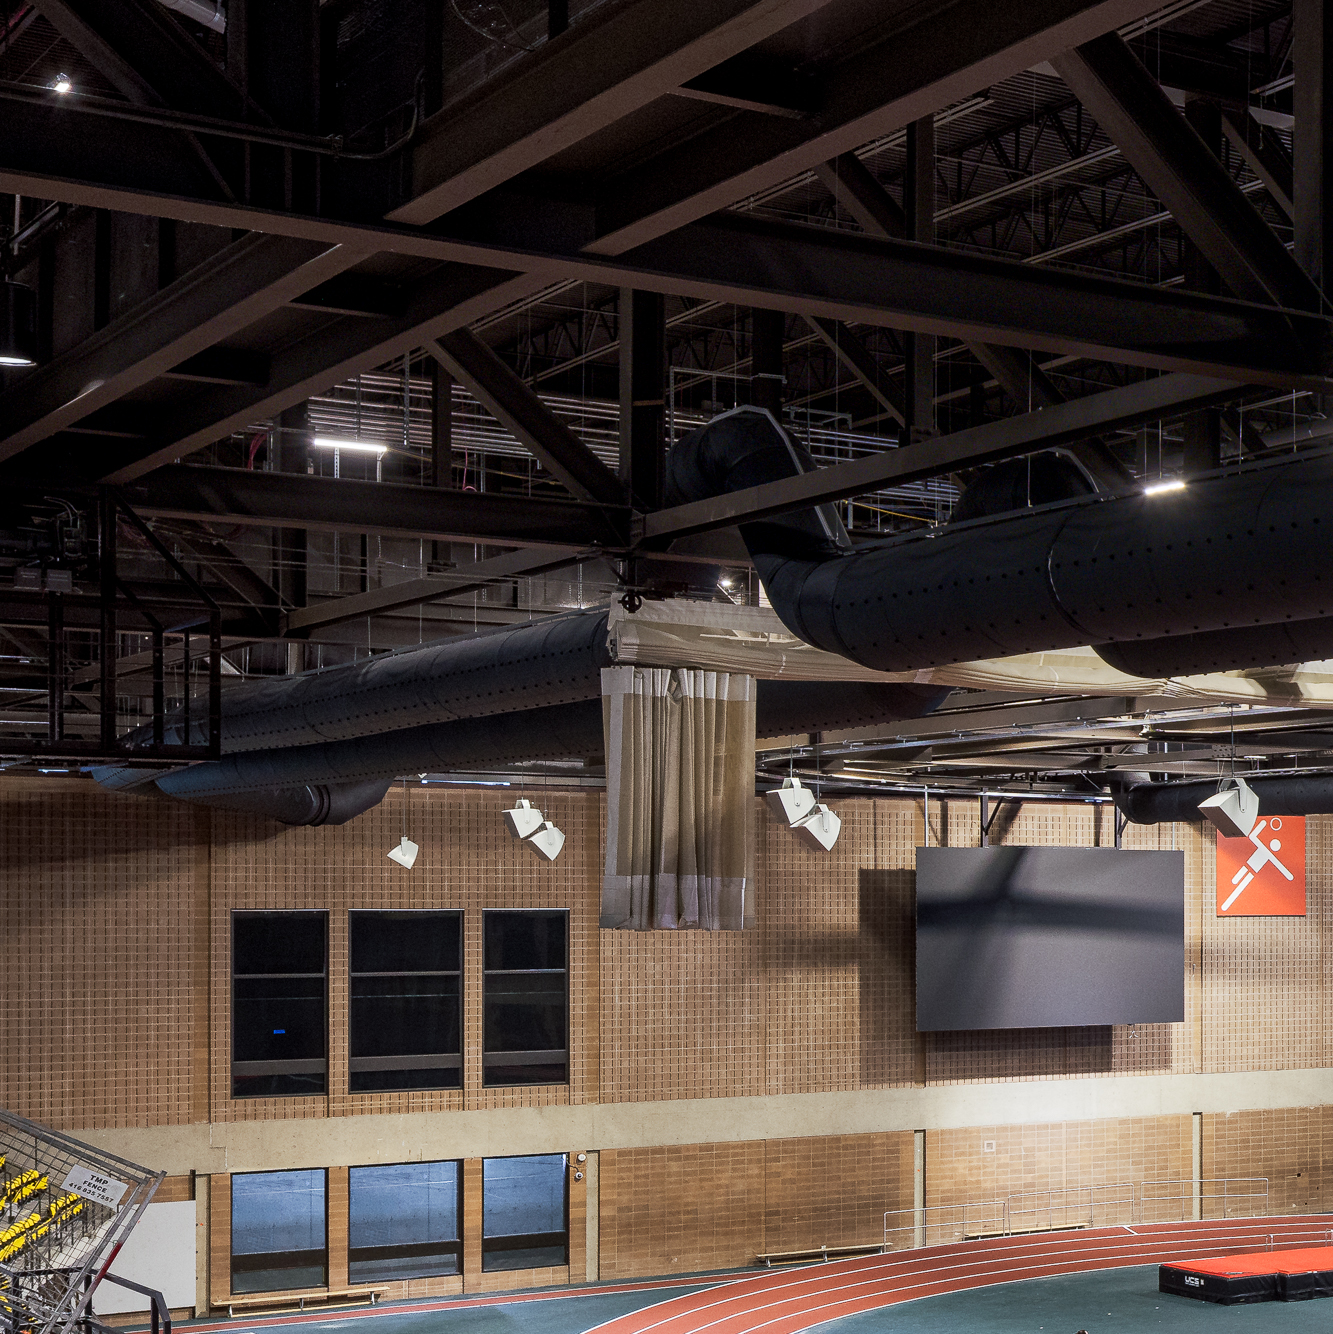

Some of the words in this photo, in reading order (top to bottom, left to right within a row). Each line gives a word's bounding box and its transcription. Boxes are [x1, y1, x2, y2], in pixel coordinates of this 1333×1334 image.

[90, 1174, 109, 1185] TMP
[68, 1182, 83, 1191] 416
[82, 1187, 96, 1197] 835
[83, 1180, 108, 1194] FENCE
[1184, 1275, 1200, 1285] UCS
